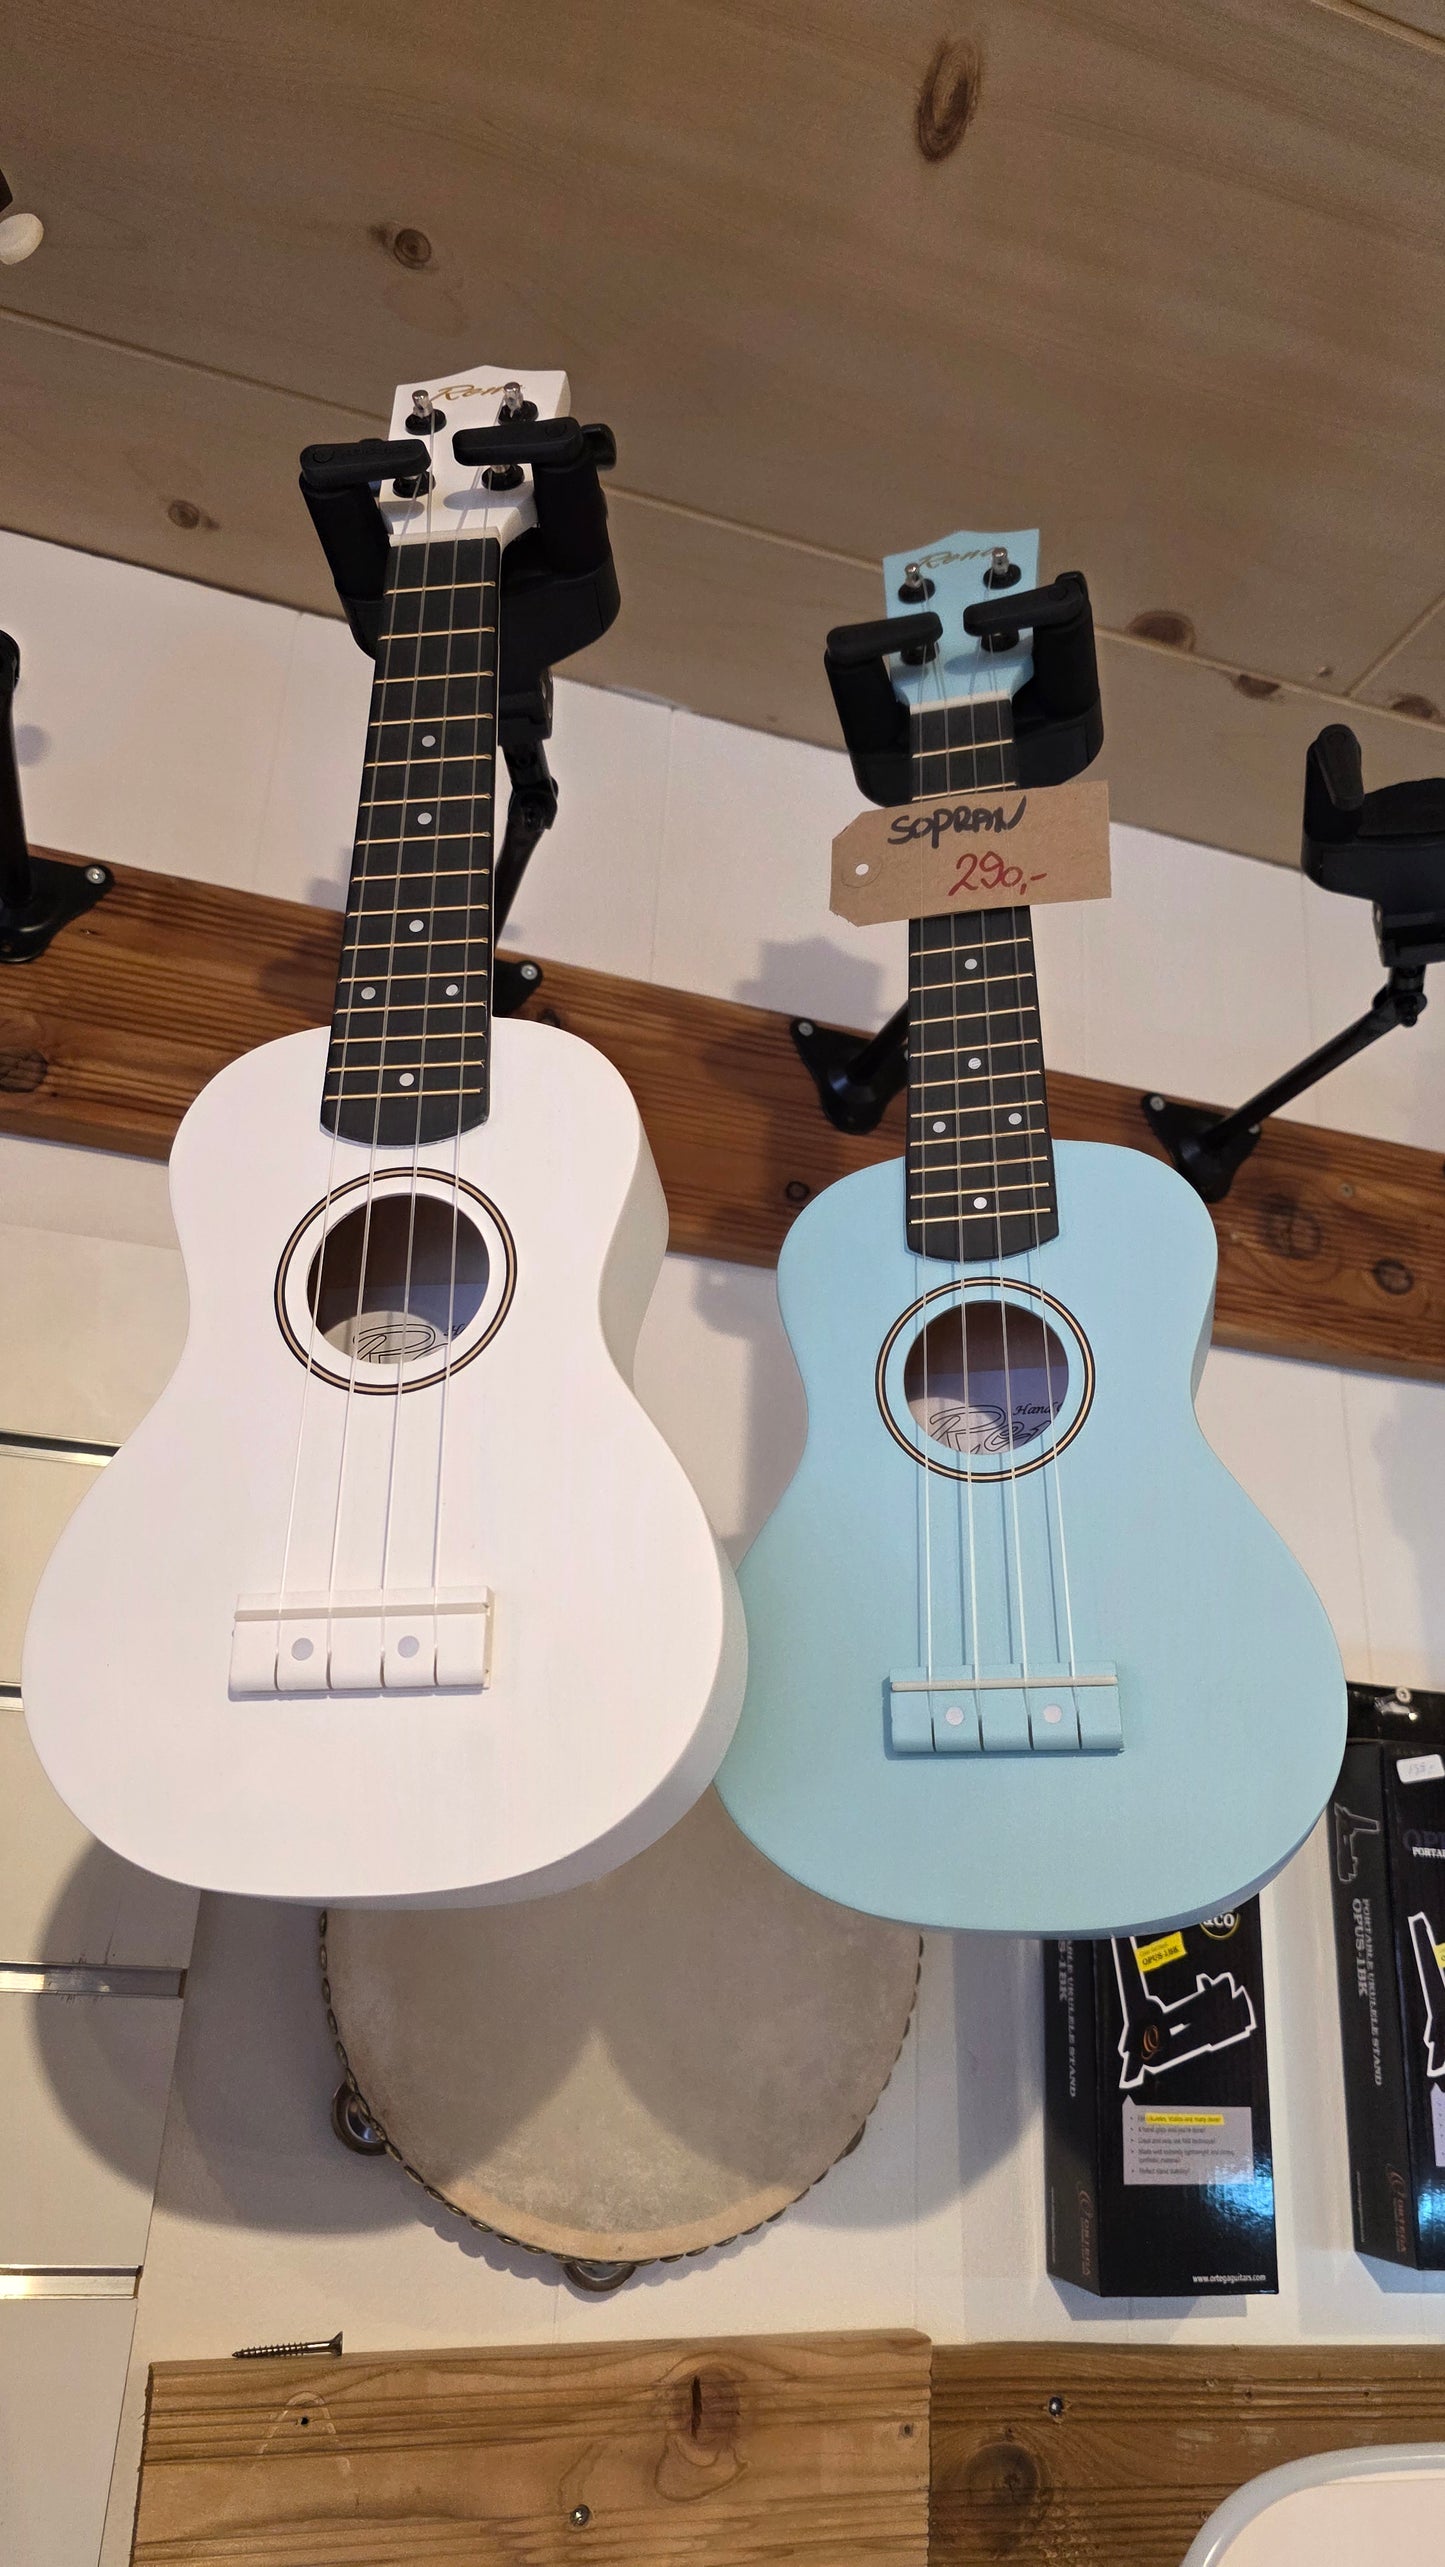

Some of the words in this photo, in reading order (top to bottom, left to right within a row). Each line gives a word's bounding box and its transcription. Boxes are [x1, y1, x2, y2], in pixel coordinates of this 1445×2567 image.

[887, 795, 1027, 849] SOPRAN
[948, 851, 1048, 896] 290,-
[1352, 1898, 1368, 1998] OPUS-1BK
[1068, 2046, 1077, 2098] STAND
[1372, 2038, 1382, 2086] STAND
